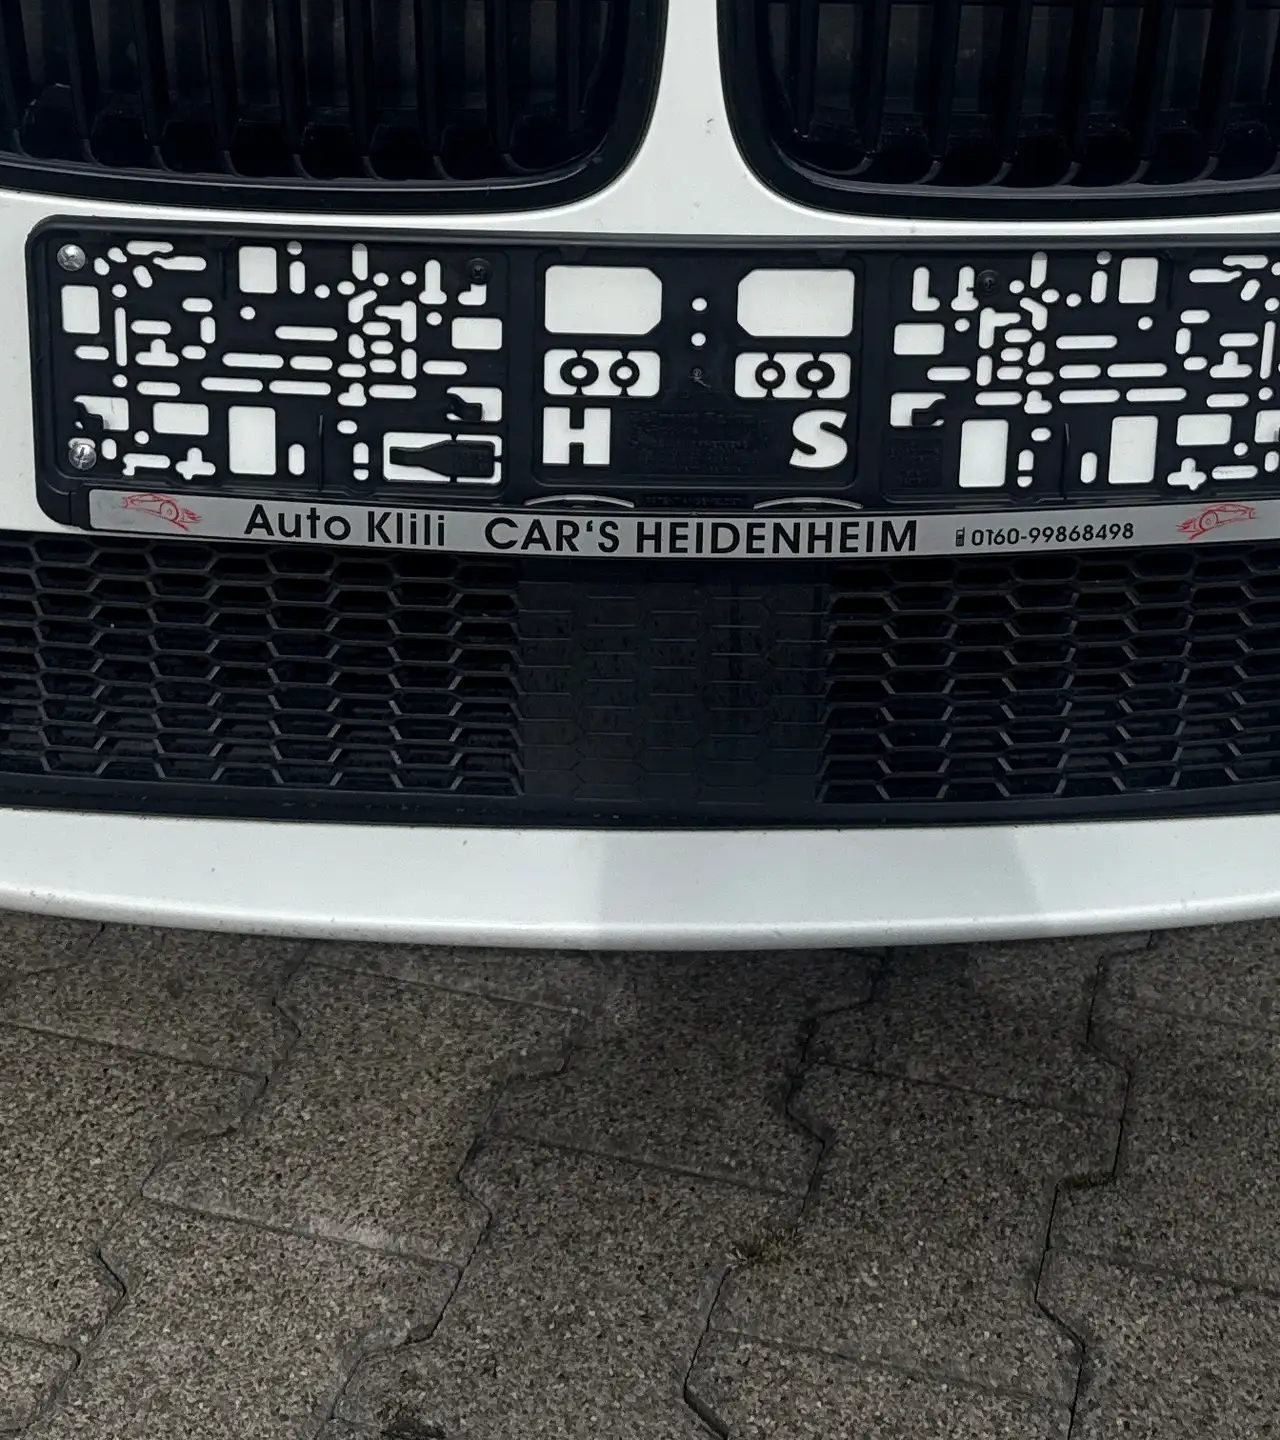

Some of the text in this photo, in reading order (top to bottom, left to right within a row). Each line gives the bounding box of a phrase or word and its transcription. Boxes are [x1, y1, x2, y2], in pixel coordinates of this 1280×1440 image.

[244, 504, 351, 540] Auto
[636, 520, 917, 554] HEIDENHEIM
[971, 522, 1134, 547] 0160-99868498
